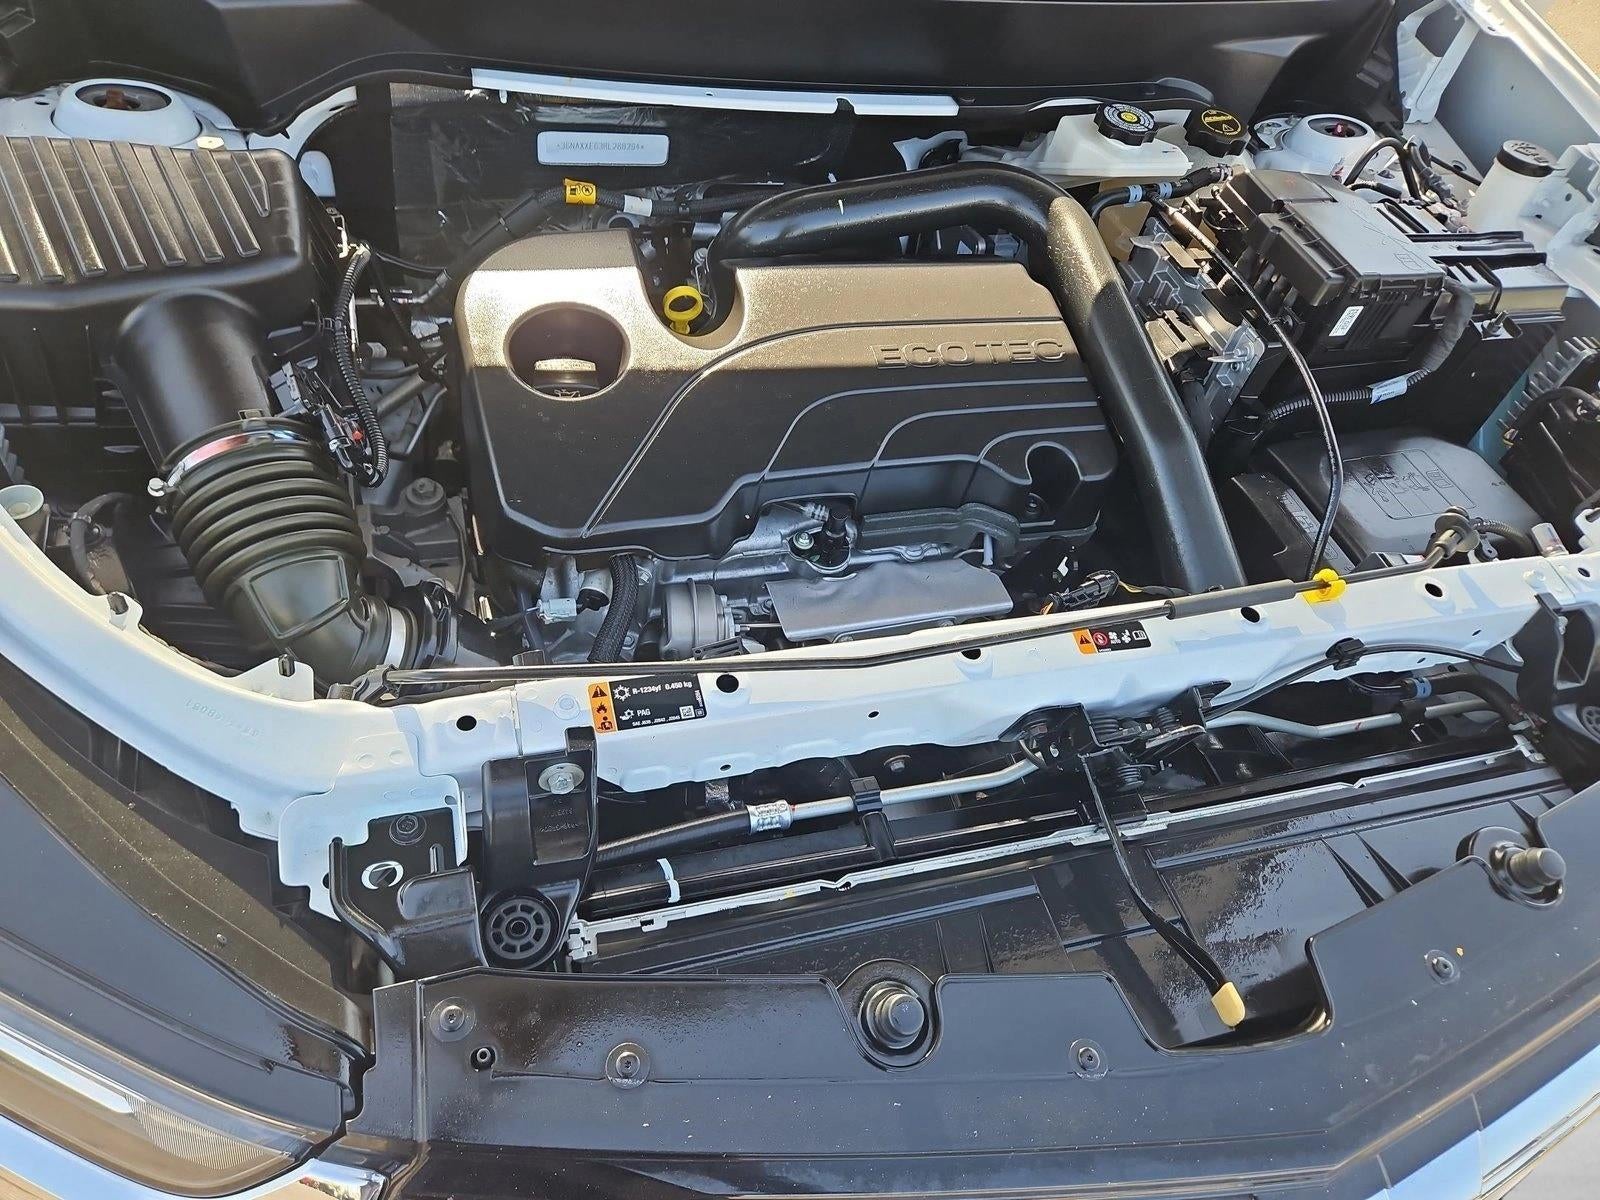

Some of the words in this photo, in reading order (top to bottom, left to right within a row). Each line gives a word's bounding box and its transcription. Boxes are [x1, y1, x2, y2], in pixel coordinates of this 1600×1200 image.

[870, 338, 1067, 370] ECOTEC
[632, 685, 661, 695] R-1234yf
[636, 708, 650, 716] PAG
